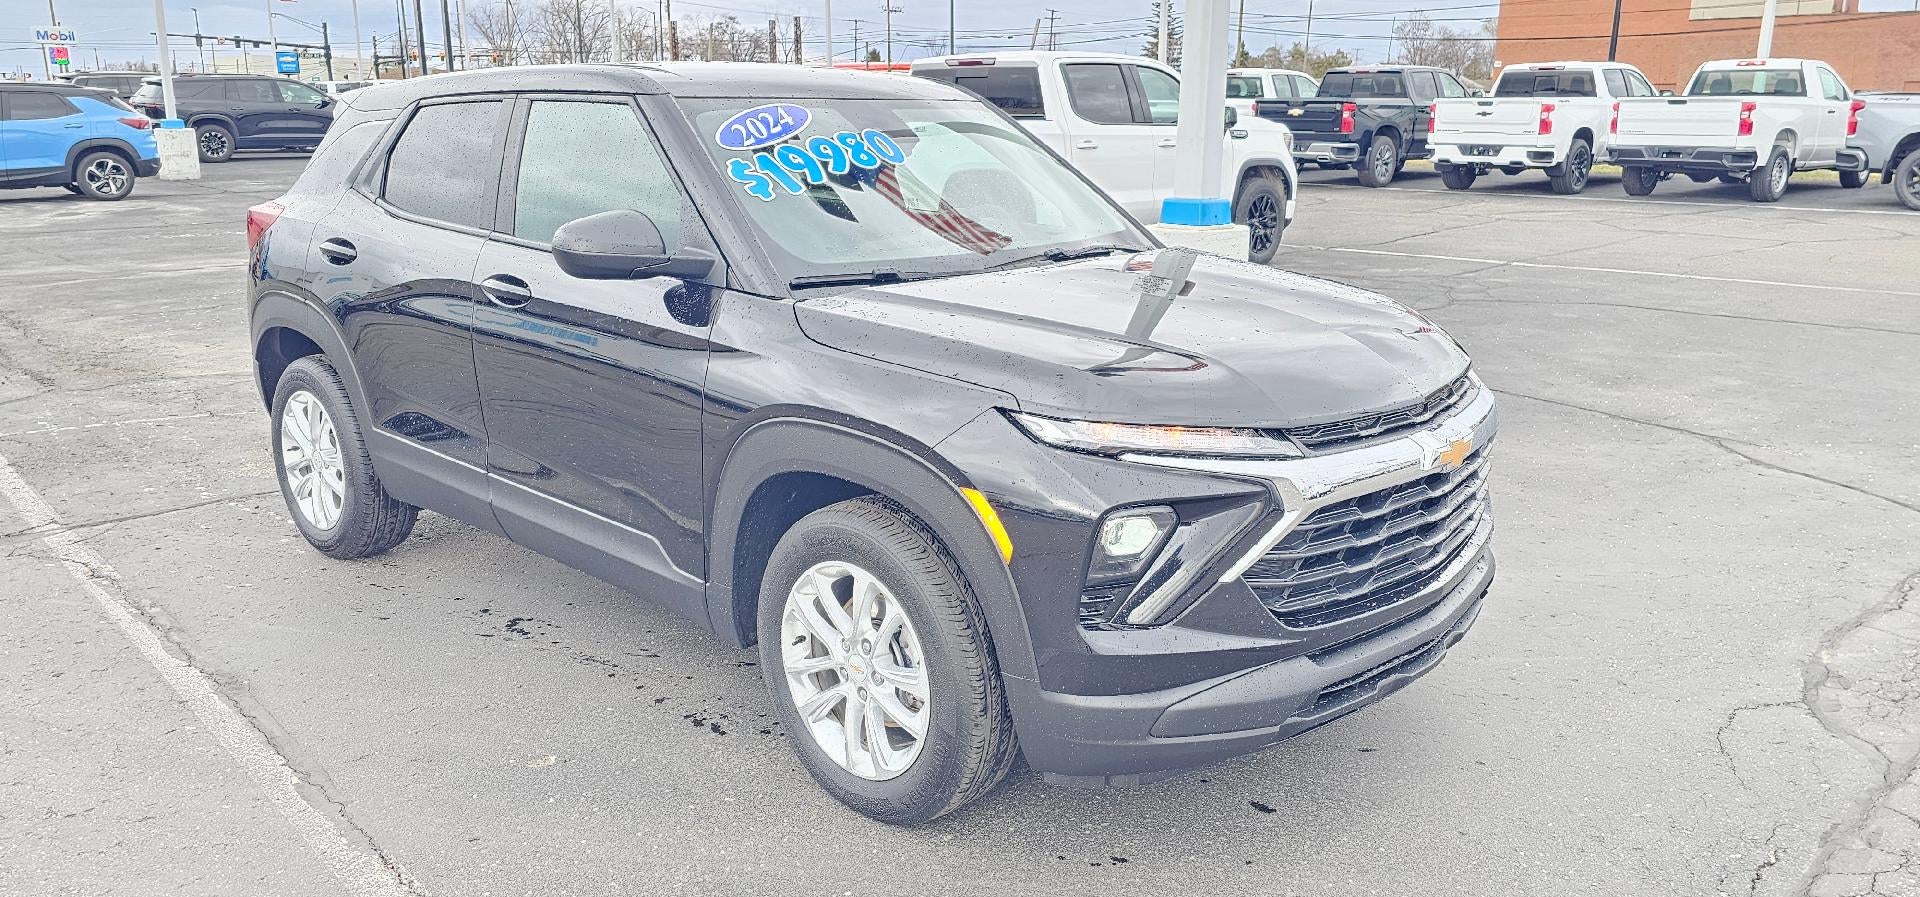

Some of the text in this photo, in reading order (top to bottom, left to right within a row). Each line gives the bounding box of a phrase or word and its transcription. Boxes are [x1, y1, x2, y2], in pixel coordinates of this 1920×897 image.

[36, 30, 76, 41] Mobil
[731, 106, 795, 147] 2024
[726, 128, 907, 202] $19980
